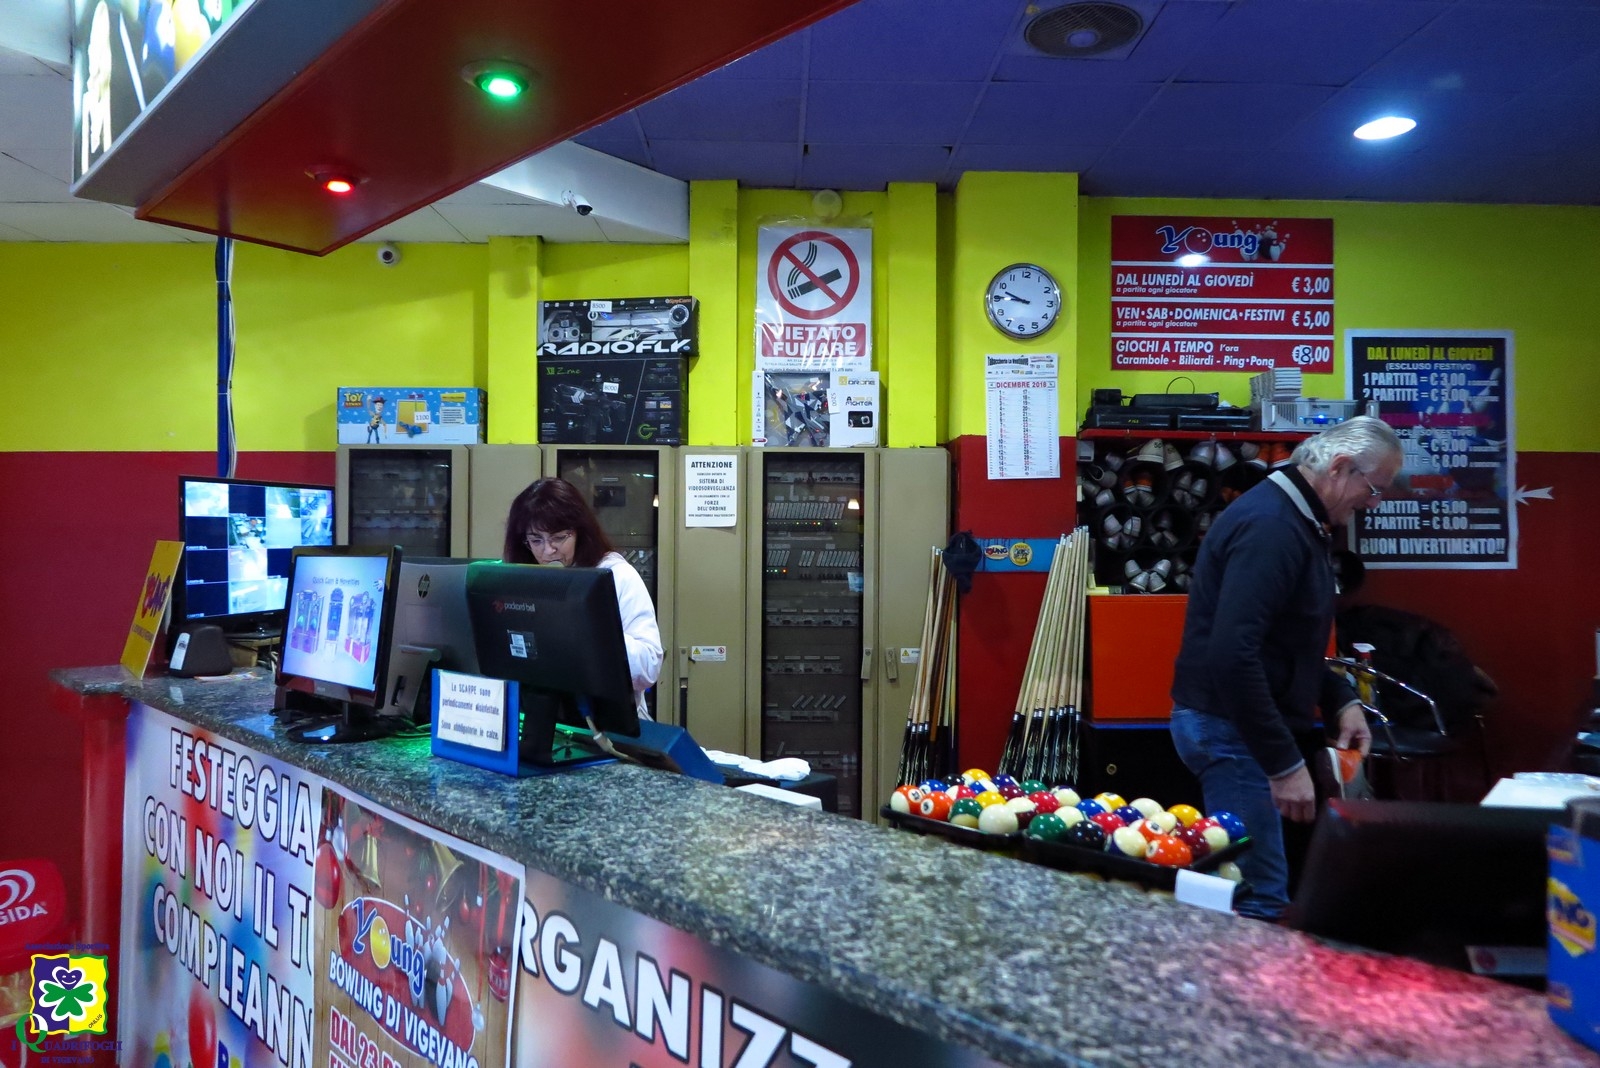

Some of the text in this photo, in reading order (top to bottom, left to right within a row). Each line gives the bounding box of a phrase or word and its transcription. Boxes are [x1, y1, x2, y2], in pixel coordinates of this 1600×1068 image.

[1156, 225, 1259, 255] Young
[1022, 271, 1031, 279] 12
[999, 282, 1007, 290] 10
[1116, 271, 1330, 295] DAL LUNEDÌ AL GIOVEDÌ € 3,00
[1123, 286, 1146, 295] partita
[1148, 287, 1164, 296] ogni
[1165, 287, 1198, 296] giocatore
[993, 295, 1001, 303] 9
[1047, 300, 1054, 308] 3
[1005, 319, 1012, 327] 7
[1031, 322, 1039, 330] 5
[1123, 320, 1146, 329] partita
[1148, 320, 1164, 329] ogni
[1165, 321, 1198, 329] giocatore
[1291, 311, 1300, 327] €
[1302, 311, 1330, 330] 5,00
[771, 326, 857, 341] VIETATO
[1018, 324, 1025, 332] 6
[773, 341, 857, 357] FUMARE
[1116, 340, 1159, 353] GIOCHI
[1161, 341, 1171, 353] A
[1174, 341, 1214, 354] TEMPO
[1367, 346, 1389, 360] DAL
[1432, 347, 1447, 360] AL
[1116, 354, 1169, 366] Carambole
[1179, 354, 1214, 367] Biliardi
[1363, 373, 1369, 386] 1
[1371, 373, 1418, 386] PARTITA
[344, 392, 364, 402] TOY
[1373, 388, 1419, 401] PARTITE
[691, 461, 733, 469] ATTENZIONE
[1365, 517, 1372, 529] 2
[1374, 517, 1420, 530] PARTITE
[1360, 538, 1398, 555] BUON
[459, 683, 477, 695] SCARPE
[170, 727, 314, 866] FESTEGGIA
[144, 796, 313, 975] CON NOI IL T
[352, 897, 424, 998] Young
[328, 950, 383, 1018] BOWLING
[386, 994, 401, 1034] DI
[330, 1005, 358, 1065] DAL
